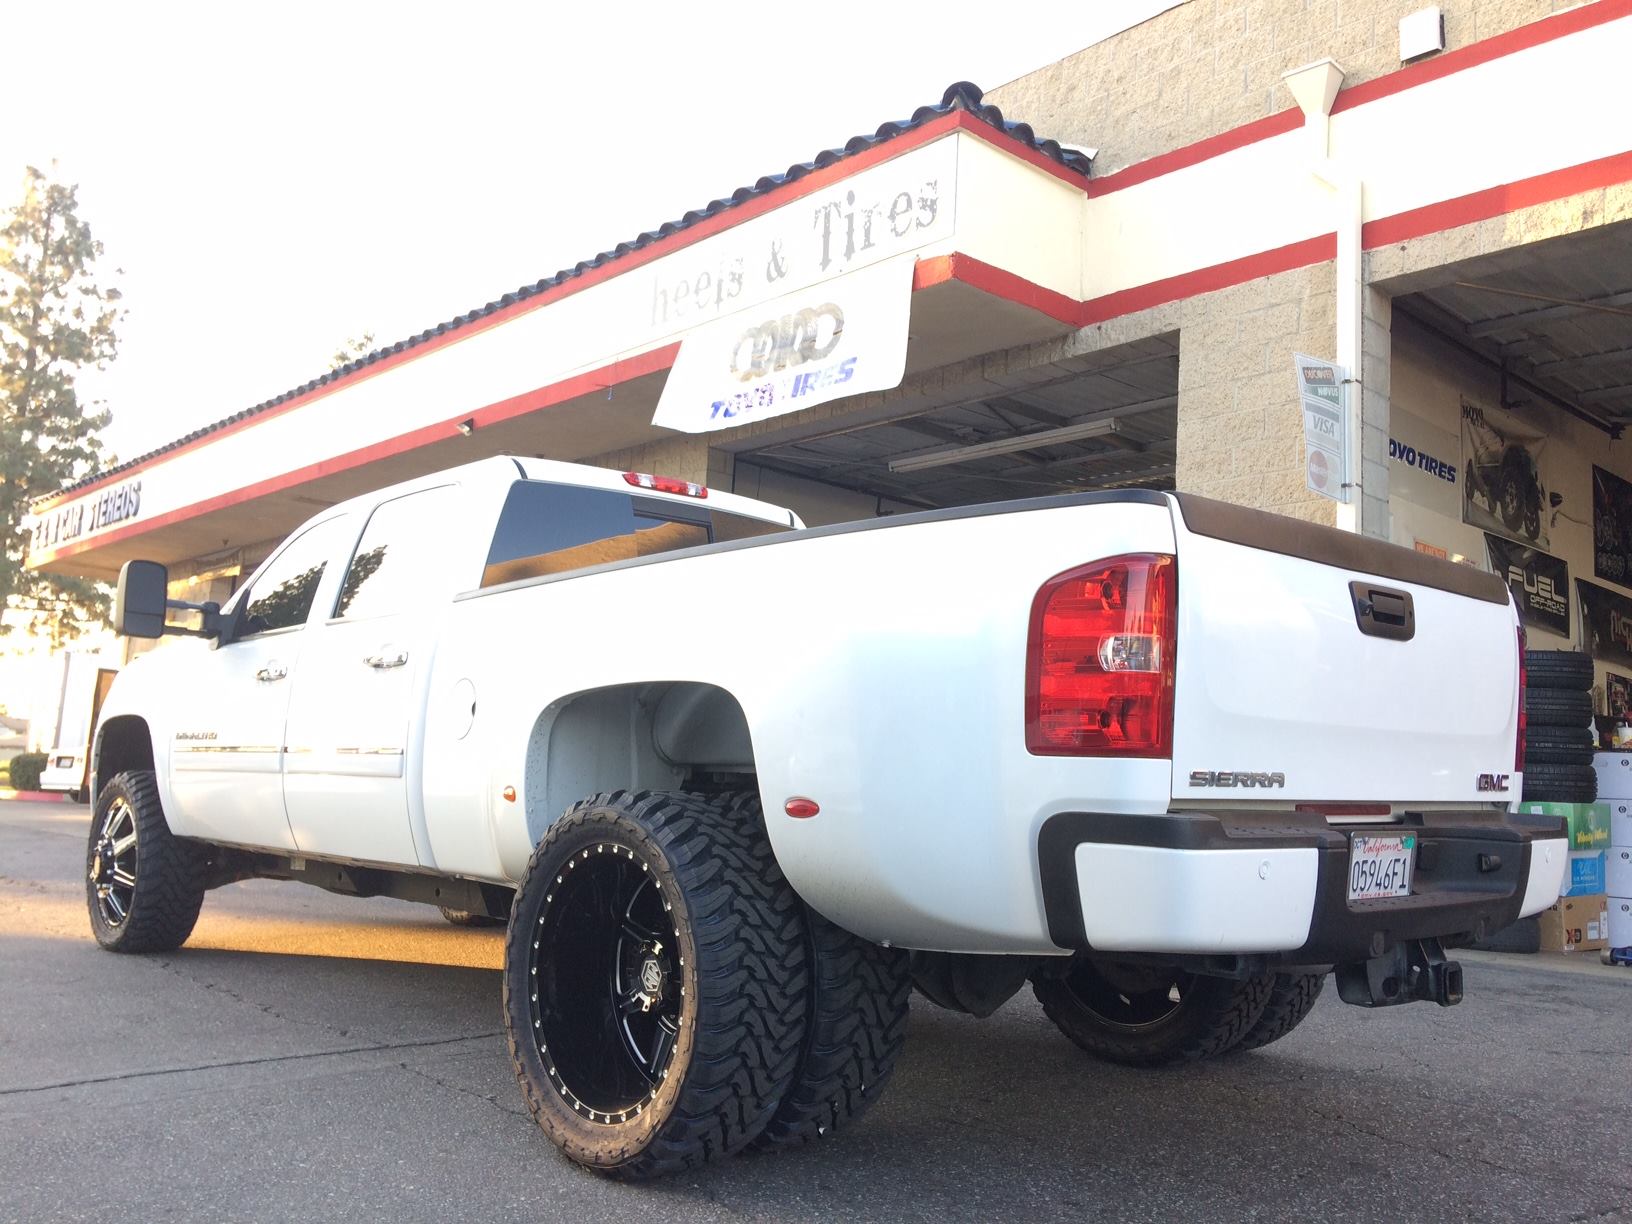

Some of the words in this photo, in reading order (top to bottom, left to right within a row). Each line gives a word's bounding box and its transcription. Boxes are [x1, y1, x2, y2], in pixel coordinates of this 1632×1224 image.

[764, 235, 791, 283] &
[812, 179, 940, 272] Tires
[1312, 415, 1336, 438] VISA
[1417, 451, 1457, 484] TIRES
[1508, 565, 1566, 604] FUEL
[1189, 771, 1286, 789] SIERRA
[1478, 774, 1510, 791] GMC
[1362, 836, 1404, 858] California
[1352, 857, 1407, 893] 05946F1
